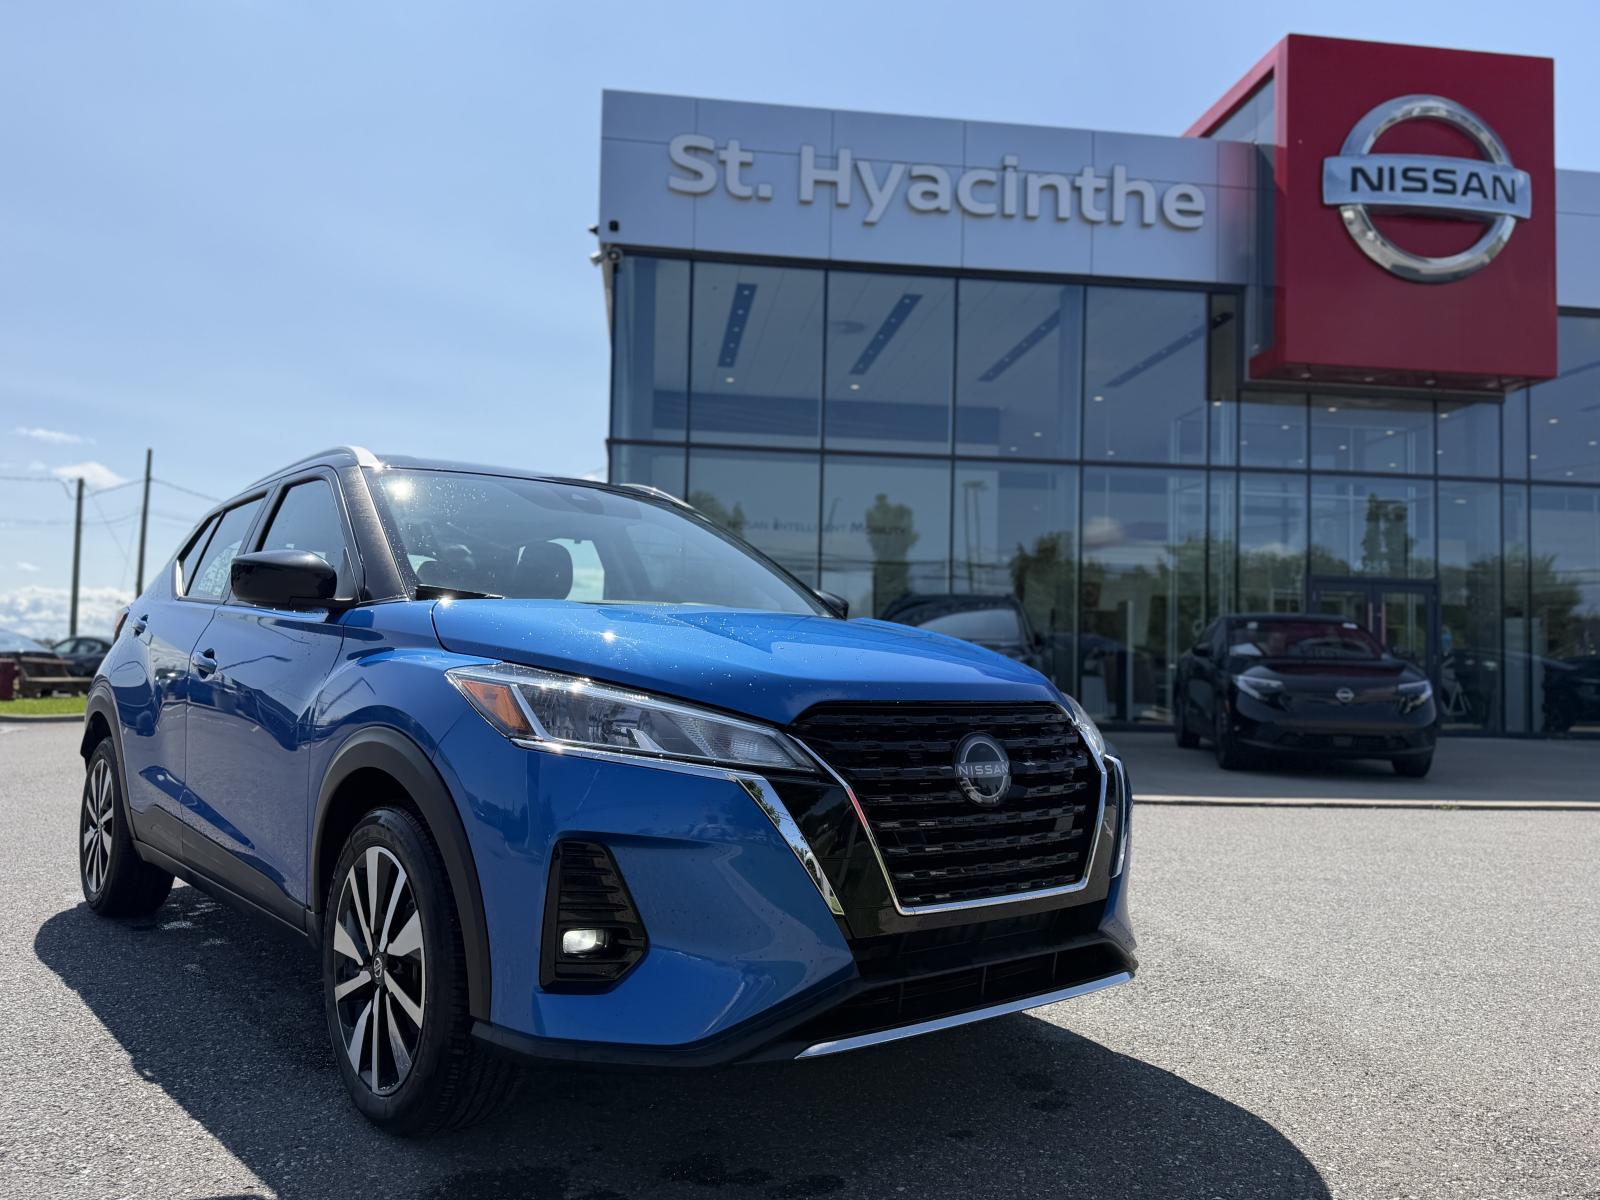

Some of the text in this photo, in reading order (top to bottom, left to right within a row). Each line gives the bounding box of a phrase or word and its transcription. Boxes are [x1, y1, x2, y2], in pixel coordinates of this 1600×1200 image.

[668, 133, 1205, 229] St. Hyacinthe
[1351, 165, 1516, 204] NISSAN
[959, 764, 1009, 776] NISSAN
